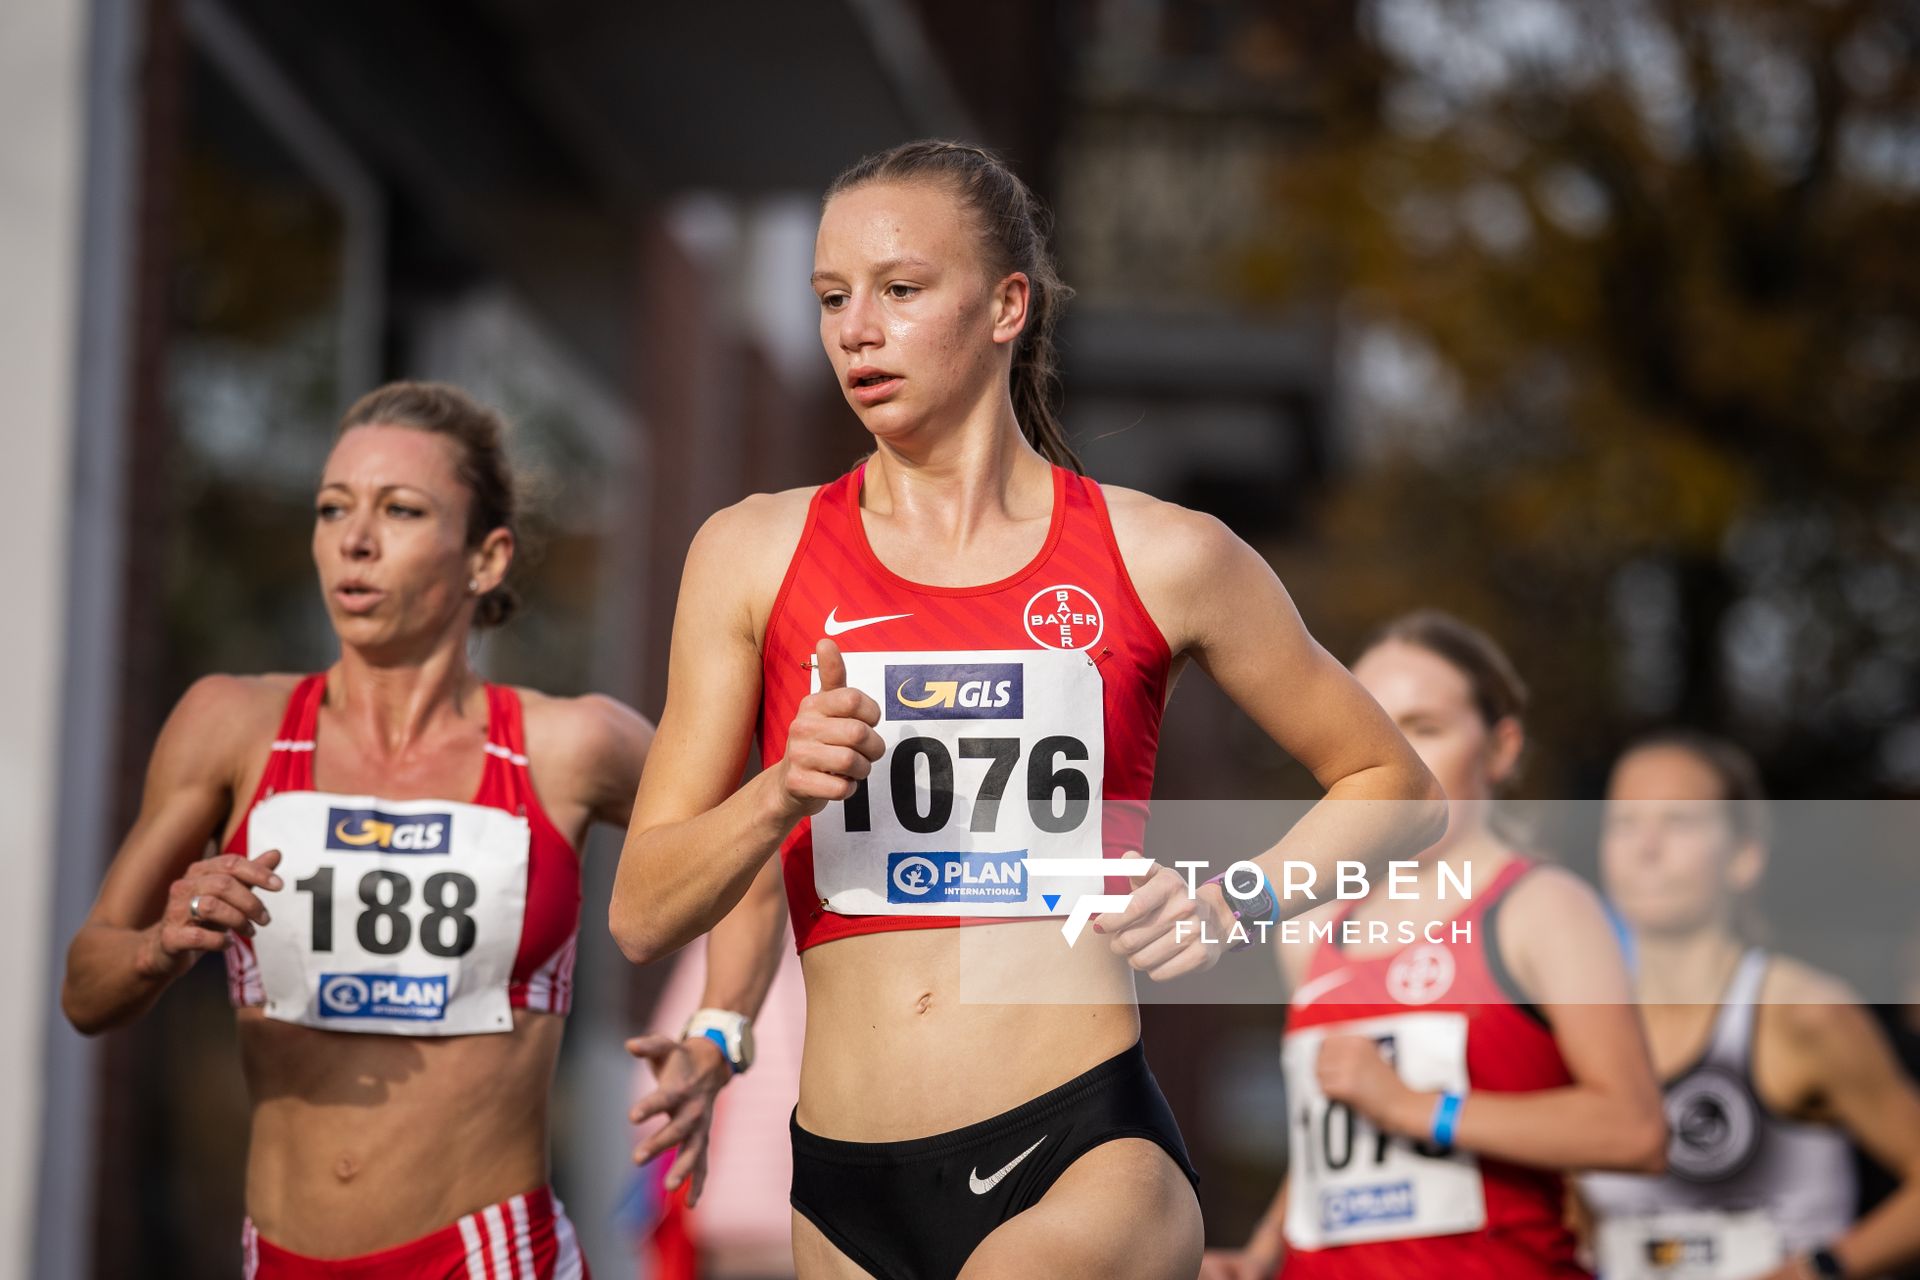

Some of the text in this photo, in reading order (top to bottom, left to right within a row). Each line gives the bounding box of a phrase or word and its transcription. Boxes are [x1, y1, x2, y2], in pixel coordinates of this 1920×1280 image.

[1031, 613, 1098, 626] BAYER
[1056, 591, 1074, 648] BAYER
[957, 680, 1011, 708] GLS
[391, 822, 442, 849] GLS
[944, 861, 1021, 884] PLAN
[944, 887, 1022, 896] INTERNATIONAL
[296, 866, 477, 958] 188
[371, 980, 443, 1005] PLAN
